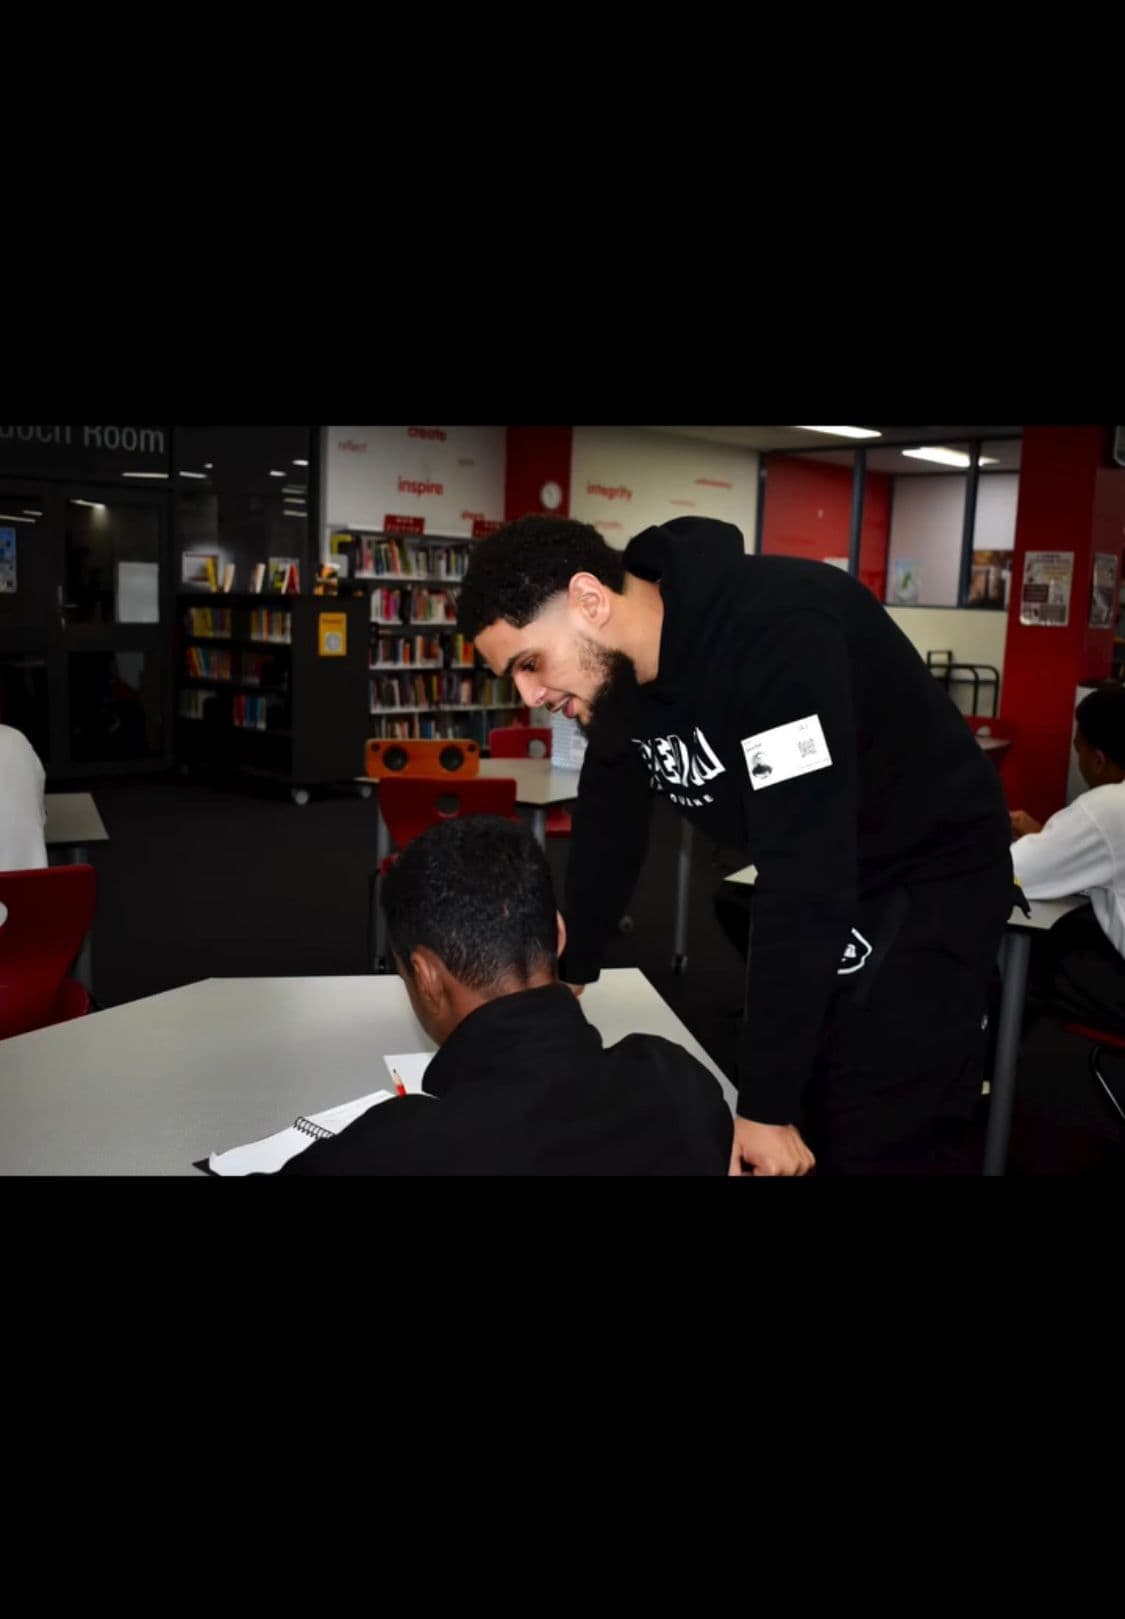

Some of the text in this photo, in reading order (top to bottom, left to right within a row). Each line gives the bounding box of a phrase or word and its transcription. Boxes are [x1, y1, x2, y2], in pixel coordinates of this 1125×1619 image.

[83, 425, 165, 454] Room
[397, 475, 444, 497] inspire
[586, 481, 633, 503] integrity
